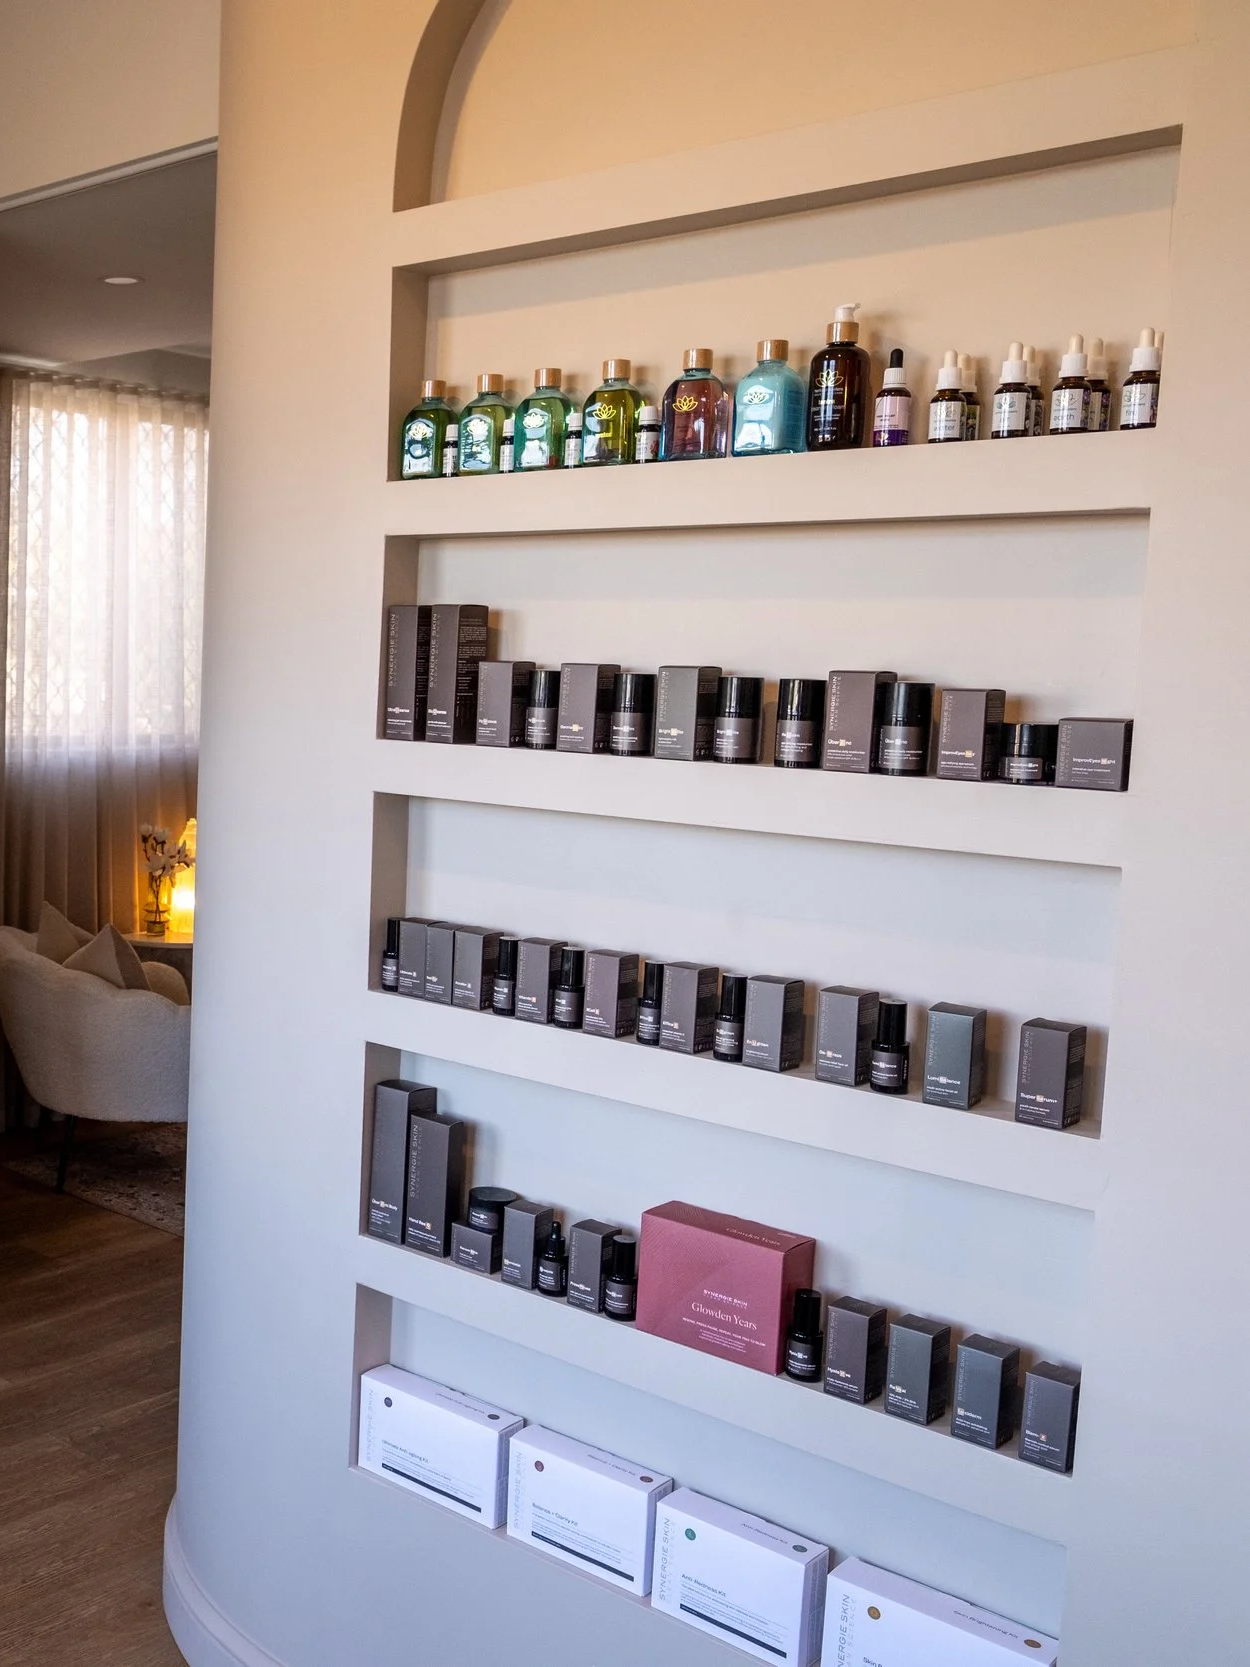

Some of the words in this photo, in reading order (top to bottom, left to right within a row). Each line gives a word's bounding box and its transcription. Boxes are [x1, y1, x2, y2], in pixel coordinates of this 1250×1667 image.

[409, 1149, 418, 1198] SYNERGIE
[691, 1302, 732, 1322] Glowden
[733, 1315, 758, 1331] Years
[663, 1517, 671, 1544] SKIN
[659, 1546, 669, 1601] SYNERGIE
[841, 1594, 851, 1624] SKIN
[837, 1625, 848, 1667] NERGIE
[863, 1656, 876, 1667] Skin
